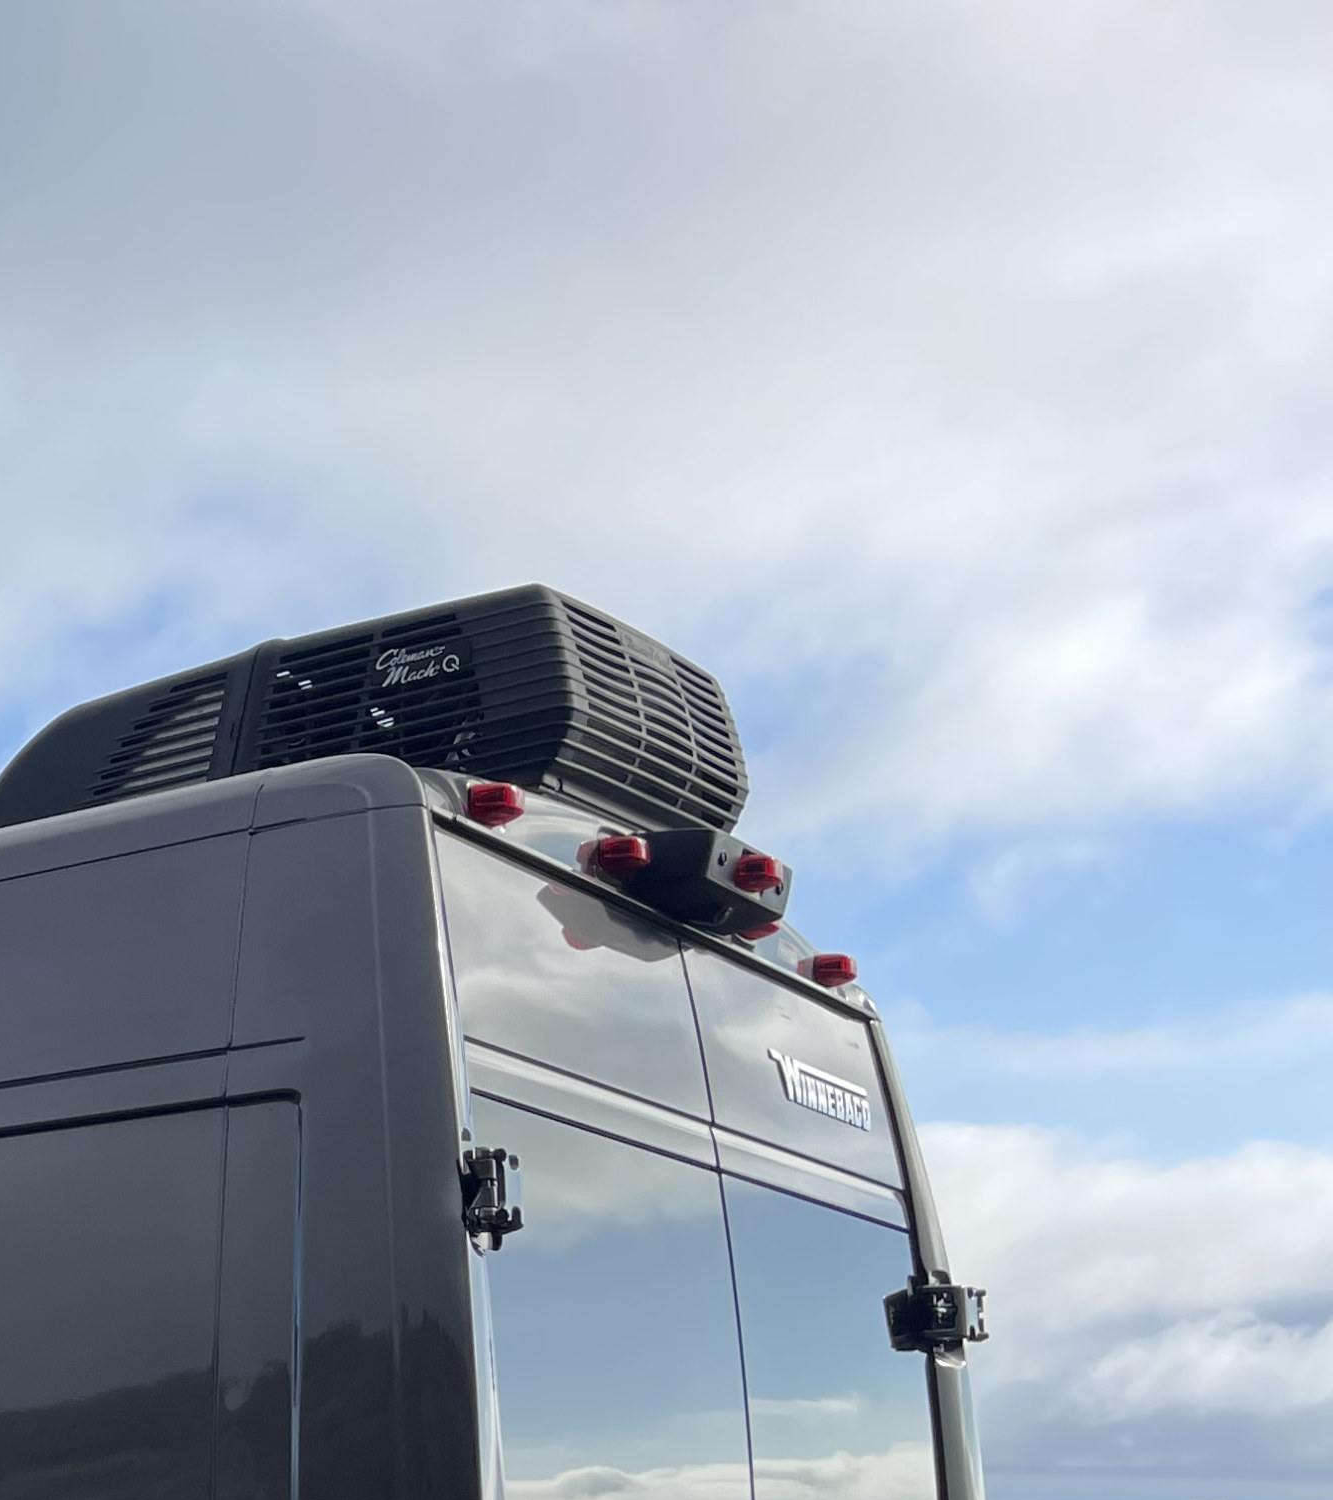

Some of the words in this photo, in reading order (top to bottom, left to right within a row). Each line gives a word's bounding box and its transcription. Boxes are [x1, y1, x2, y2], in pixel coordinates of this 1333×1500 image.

[381, 660, 438, 688] Mach
[442, 654, 460, 673] Q
[767, 1048, 871, 1132] WINNEBAGO
